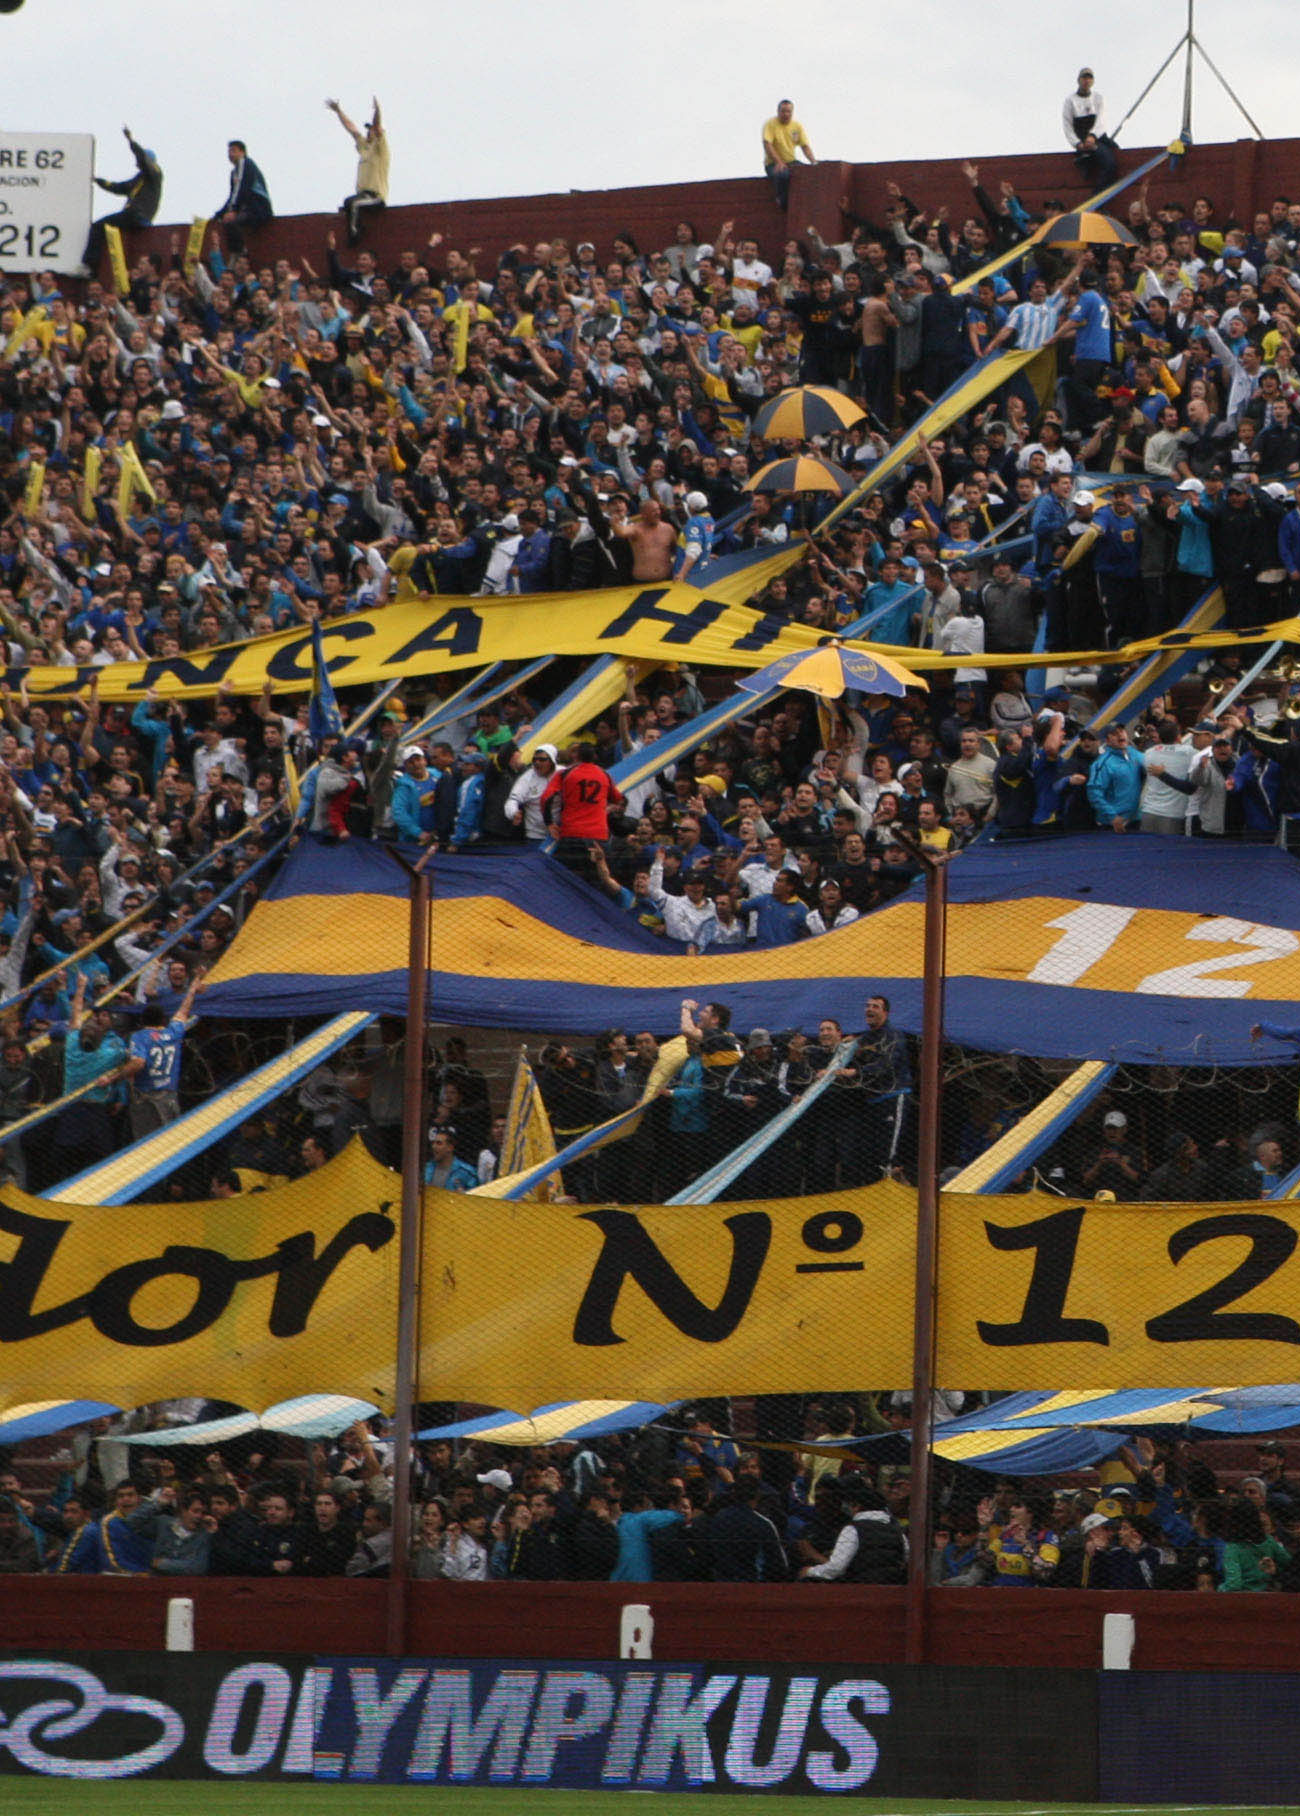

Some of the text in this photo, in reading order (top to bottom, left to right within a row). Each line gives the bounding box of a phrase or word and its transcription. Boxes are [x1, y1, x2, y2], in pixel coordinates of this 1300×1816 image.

[35, 151, 64, 168] 62
[577, 779, 602, 804] 12
[1025, 902, 1300, 999] 12
[149, 1046, 176, 1076] 27
[202, 1662, 891, 1792] OLYMPIKUS
